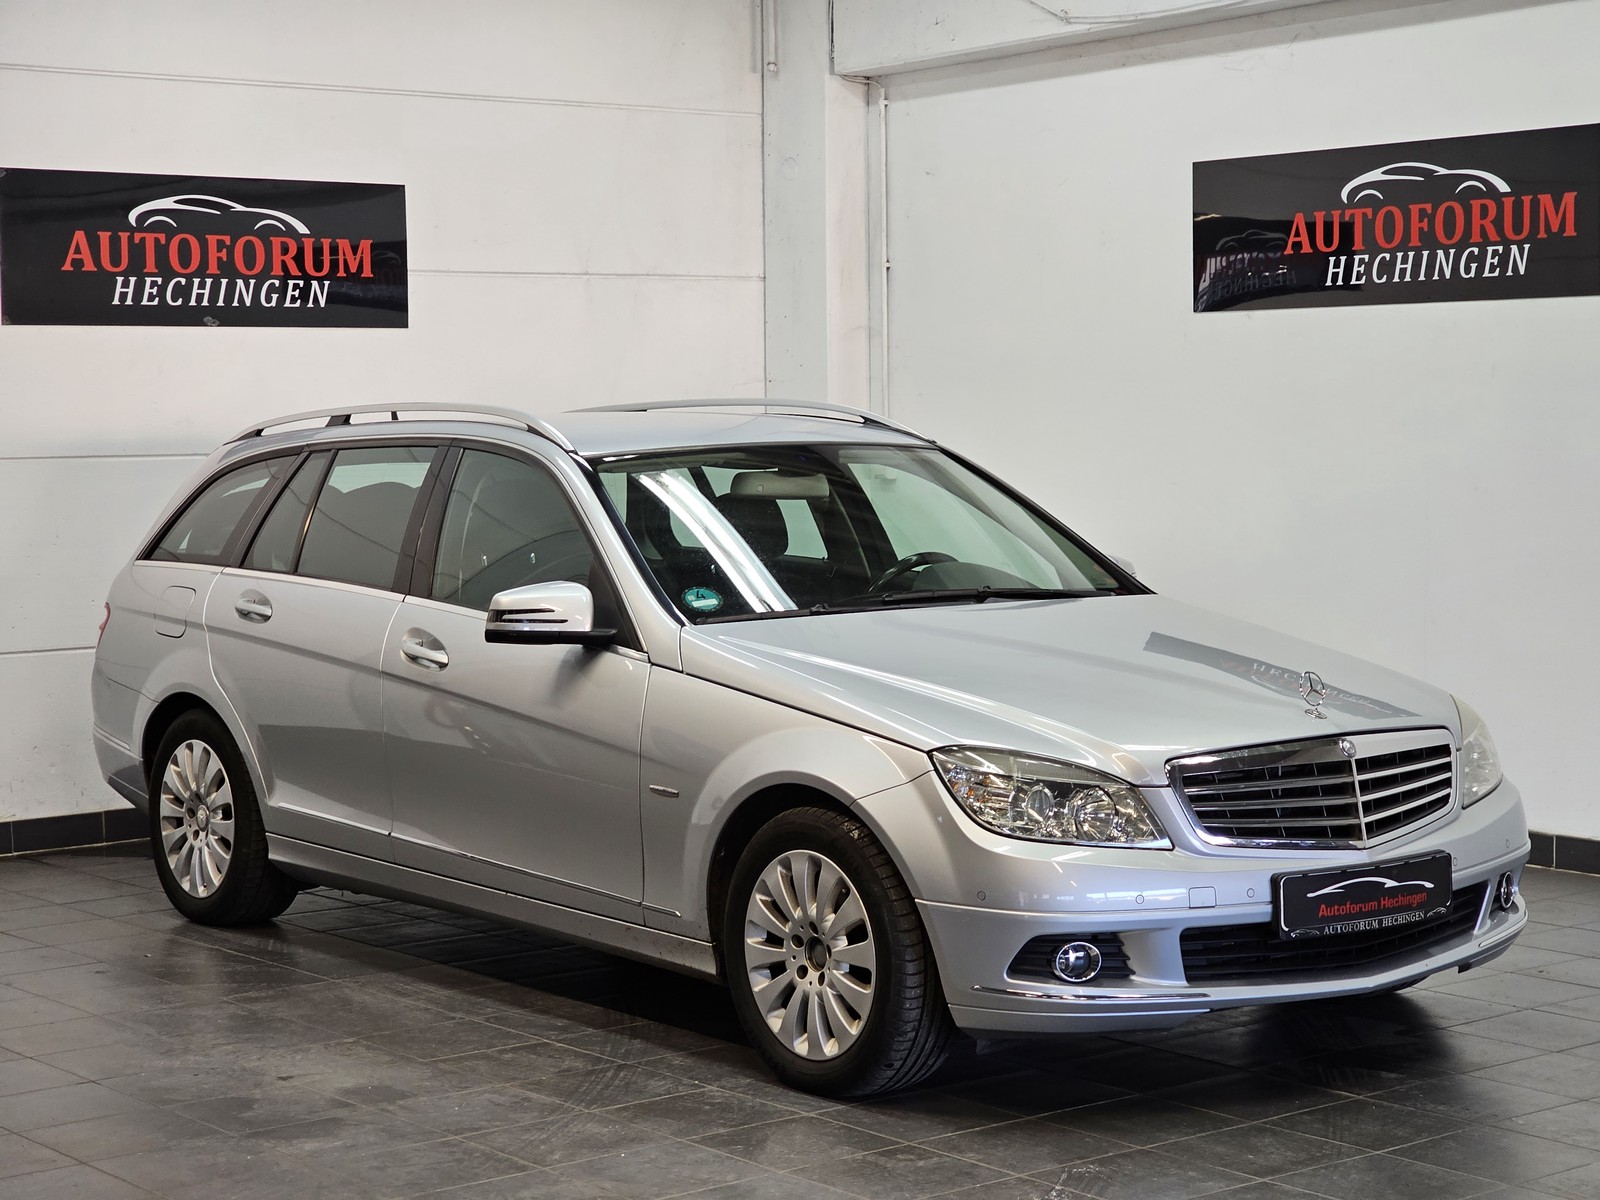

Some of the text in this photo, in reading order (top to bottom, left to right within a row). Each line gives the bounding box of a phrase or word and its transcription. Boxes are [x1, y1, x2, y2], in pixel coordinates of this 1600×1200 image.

[1284, 191, 1578, 255] AUTOFORUM
[61, 229, 374, 278] AUTOFORUM
[1325, 243, 1531, 286] HECHINGEN
[111, 276, 331, 308] HECHINGEN
[696, 589, 706, 599] 4
[1318, 892, 1427, 918] Autoforum Hechingen
[1323, 910, 1425, 935] AUTOFORUM HECHINGEN
